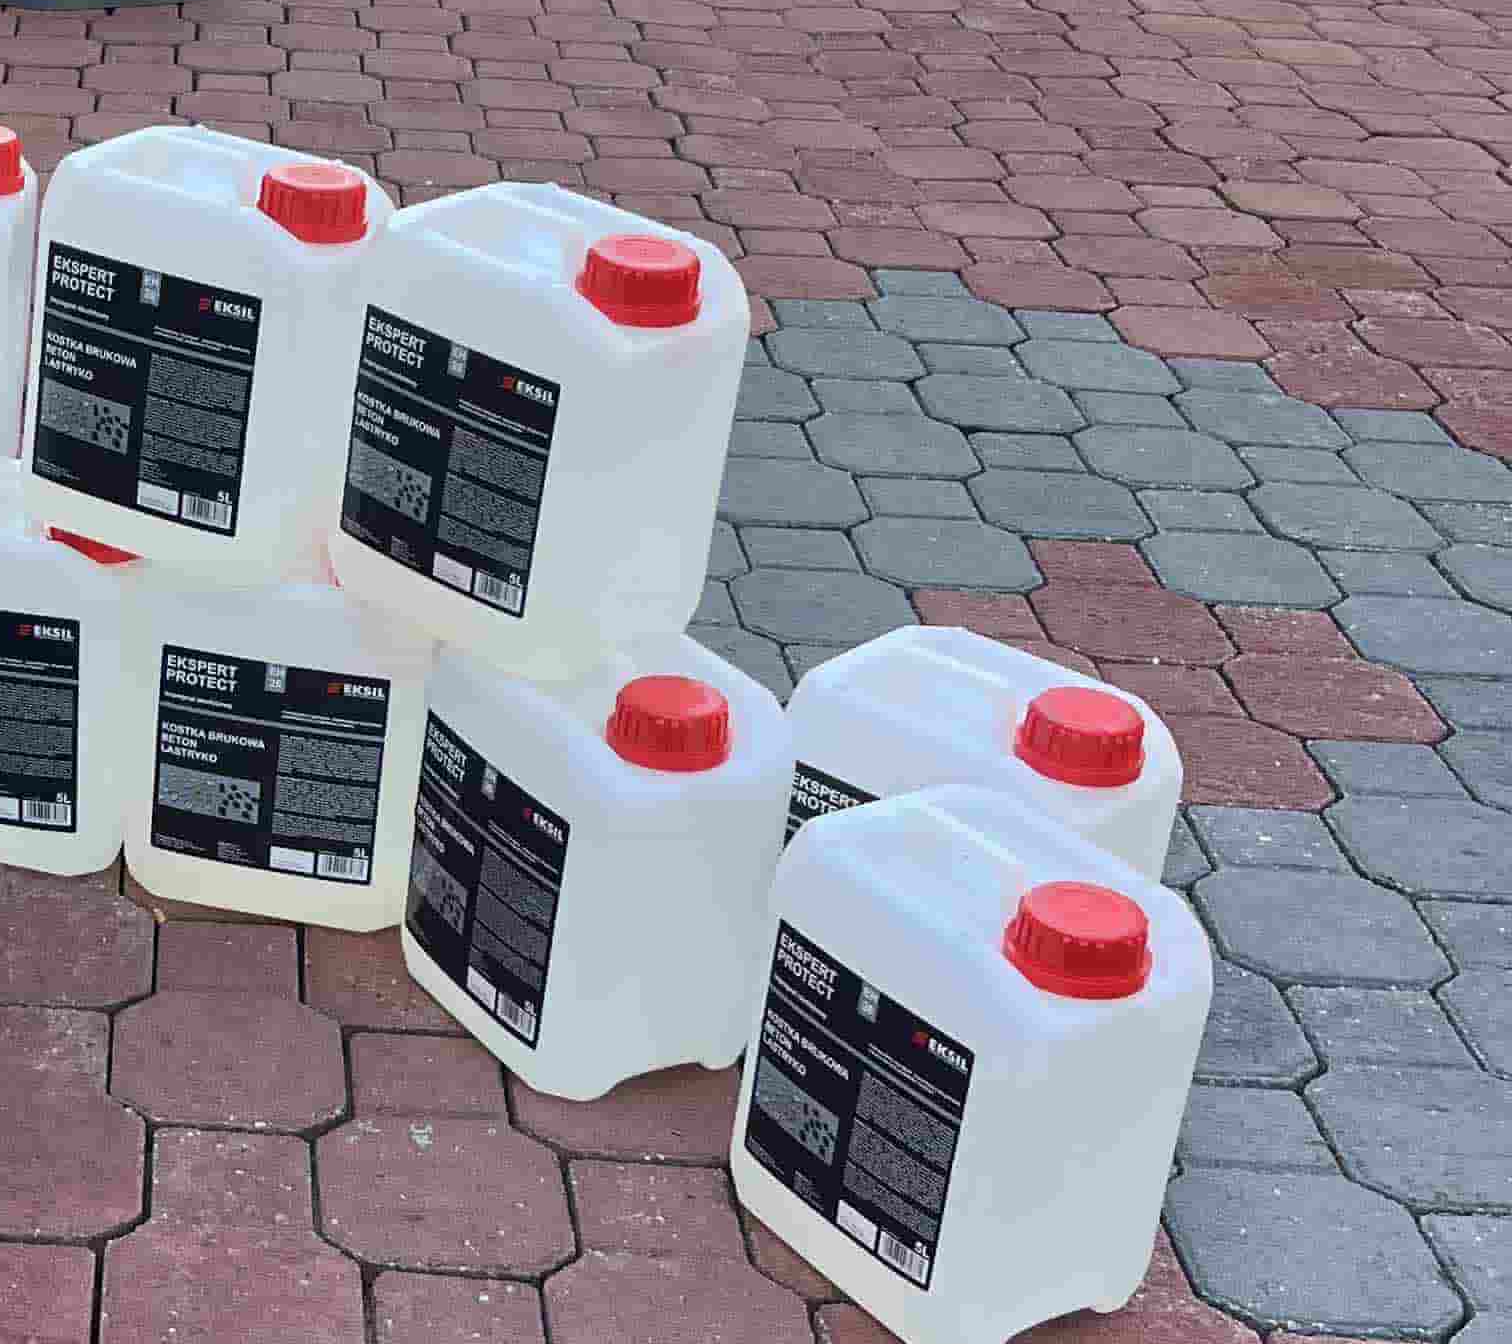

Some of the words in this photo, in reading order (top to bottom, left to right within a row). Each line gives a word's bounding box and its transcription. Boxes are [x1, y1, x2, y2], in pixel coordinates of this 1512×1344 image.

[52, 270, 119, 302] PROTECT
[54, 255, 118, 286] EKSPERT
[213, 300, 256, 321] EKSIL
[366, 331, 425, 369] PROTECT
[368, 316, 428, 353] EKSPERT
[33, 624, 76, 640] EKSIL
[166, 667, 239, 693] PROTECT
[167, 653, 239, 679] EKSPERT
[342, 683, 385, 698] EKSIL
[780, 931, 839, 985] EKSPERT
[777, 947, 836, 1001] PROTECT
